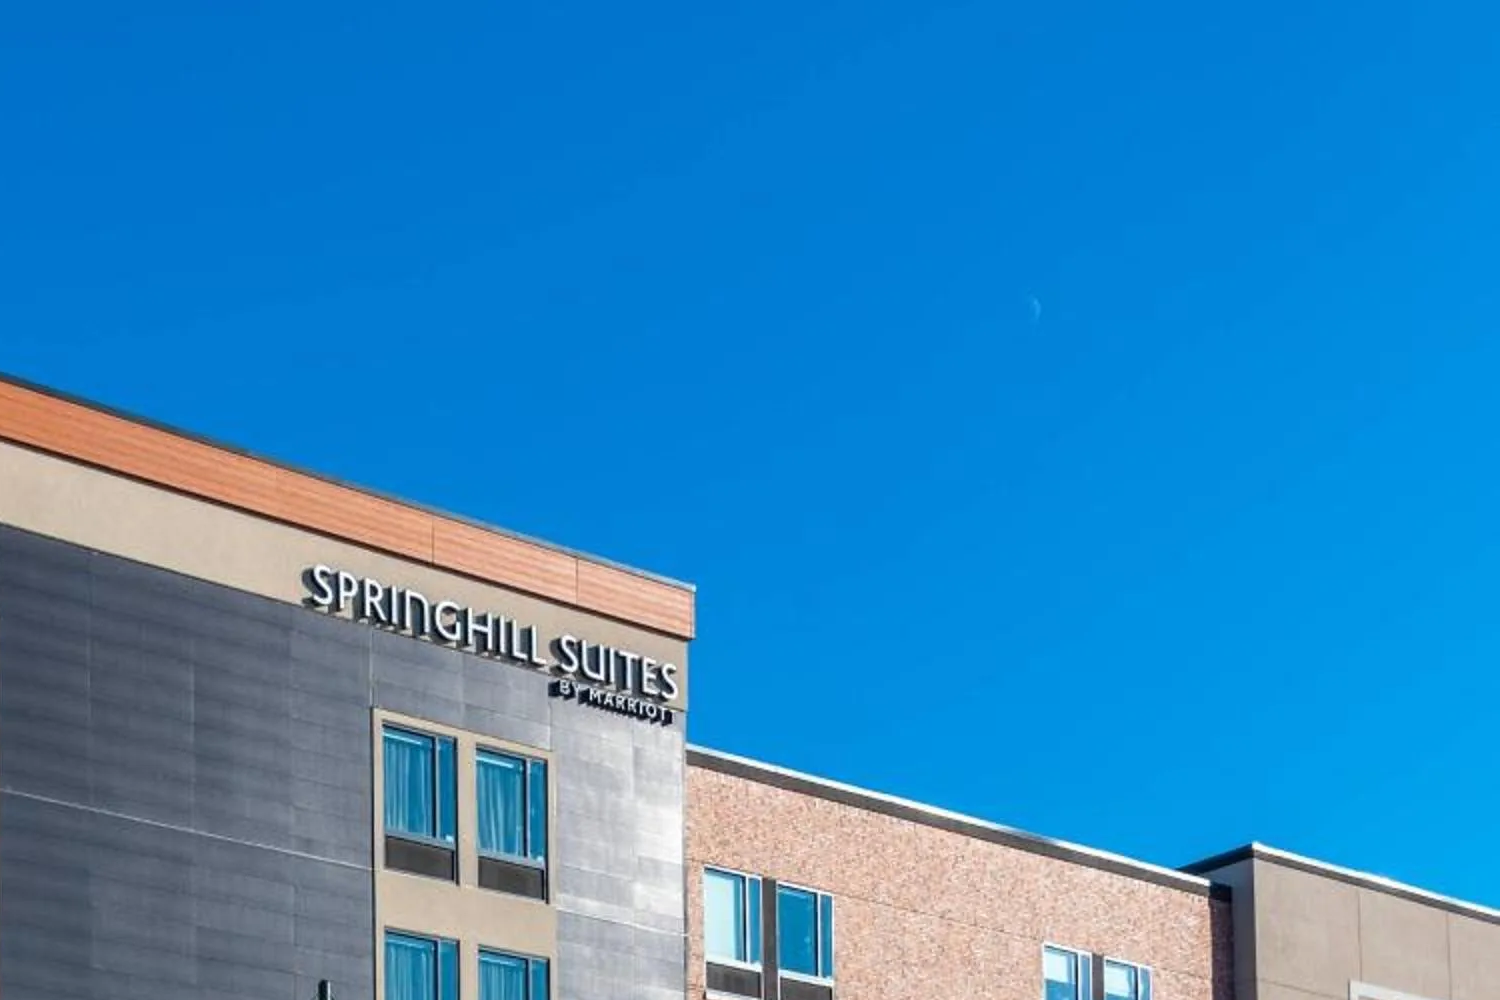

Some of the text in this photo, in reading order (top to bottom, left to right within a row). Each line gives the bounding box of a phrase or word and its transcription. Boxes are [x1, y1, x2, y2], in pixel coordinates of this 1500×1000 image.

[307, 563, 680, 701] SPRINGHILL SUITES
[559, 679, 581, 698] BY
